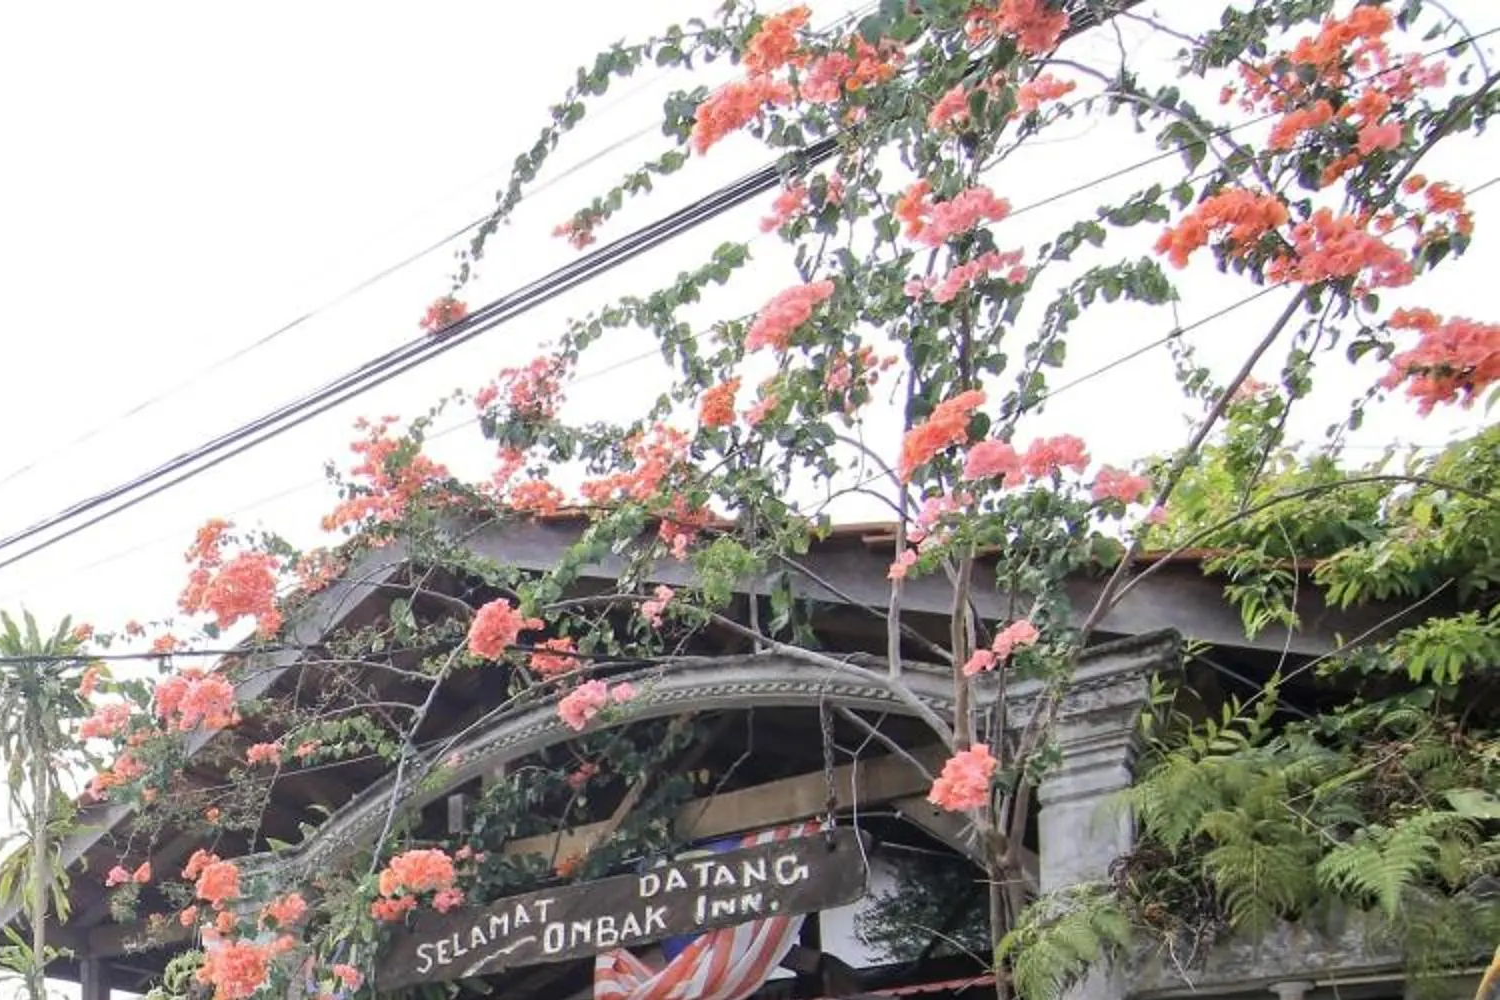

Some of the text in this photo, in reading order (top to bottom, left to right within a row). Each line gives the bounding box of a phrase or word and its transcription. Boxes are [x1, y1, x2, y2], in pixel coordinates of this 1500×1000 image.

[416, 854, 809, 974] SELAMAT DATANG
[543, 905, 669, 954] OMBAK
